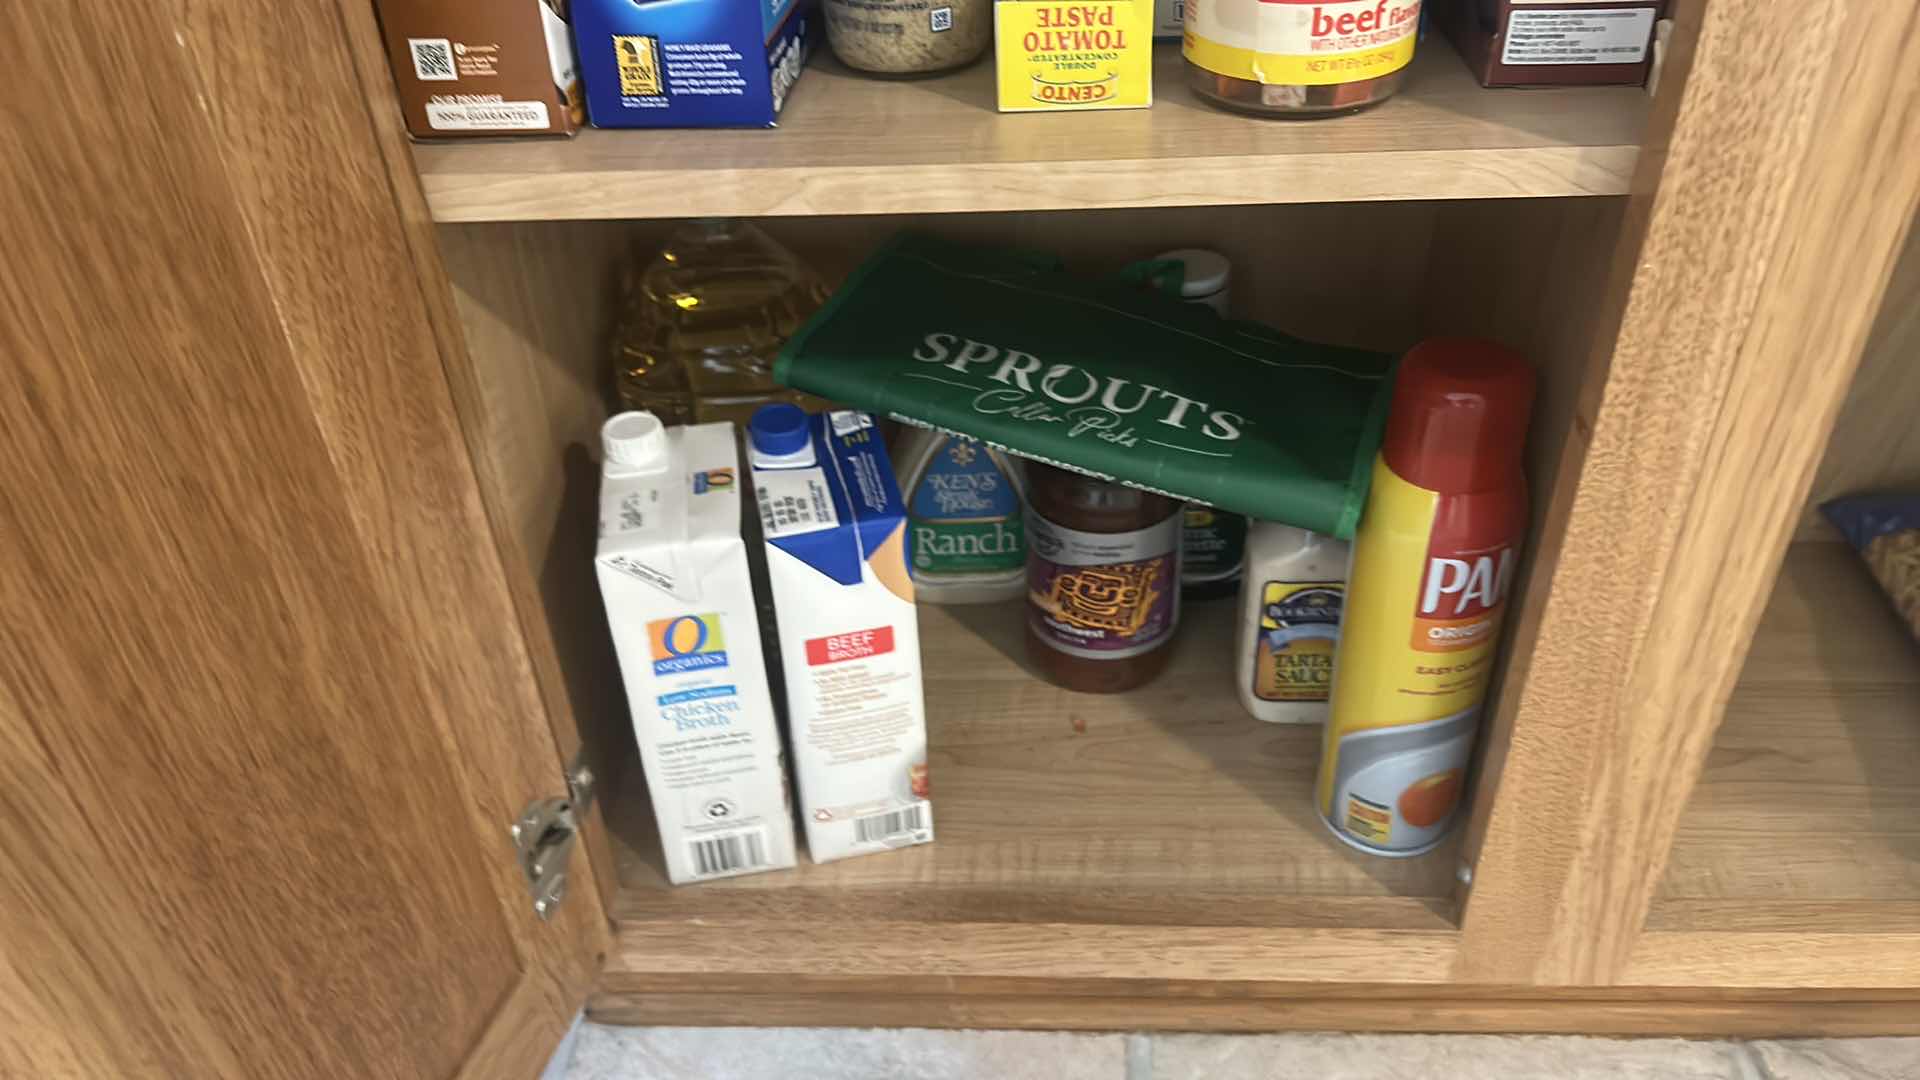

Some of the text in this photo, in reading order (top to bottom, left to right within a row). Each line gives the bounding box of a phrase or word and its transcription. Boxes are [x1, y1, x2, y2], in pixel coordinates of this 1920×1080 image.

[1036, 6, 1114, 28] PASTE
[1311, 0, 1387, 37] beef
[1023, 30, 1126, 52] TOMATO
[1041, 84, 1107, 101] CENTO
[912, 332, 1246, 441] SPROUTS
[914, 522, 1020, 556] Ranch
[827, 631, 876, 650] BEEF
[656, 653, 727, 673] organics
[828, 646, 875, 661] BROTH
[659, 700, 741, 721] Chicken
[675, 714, 731, 733] Broth
